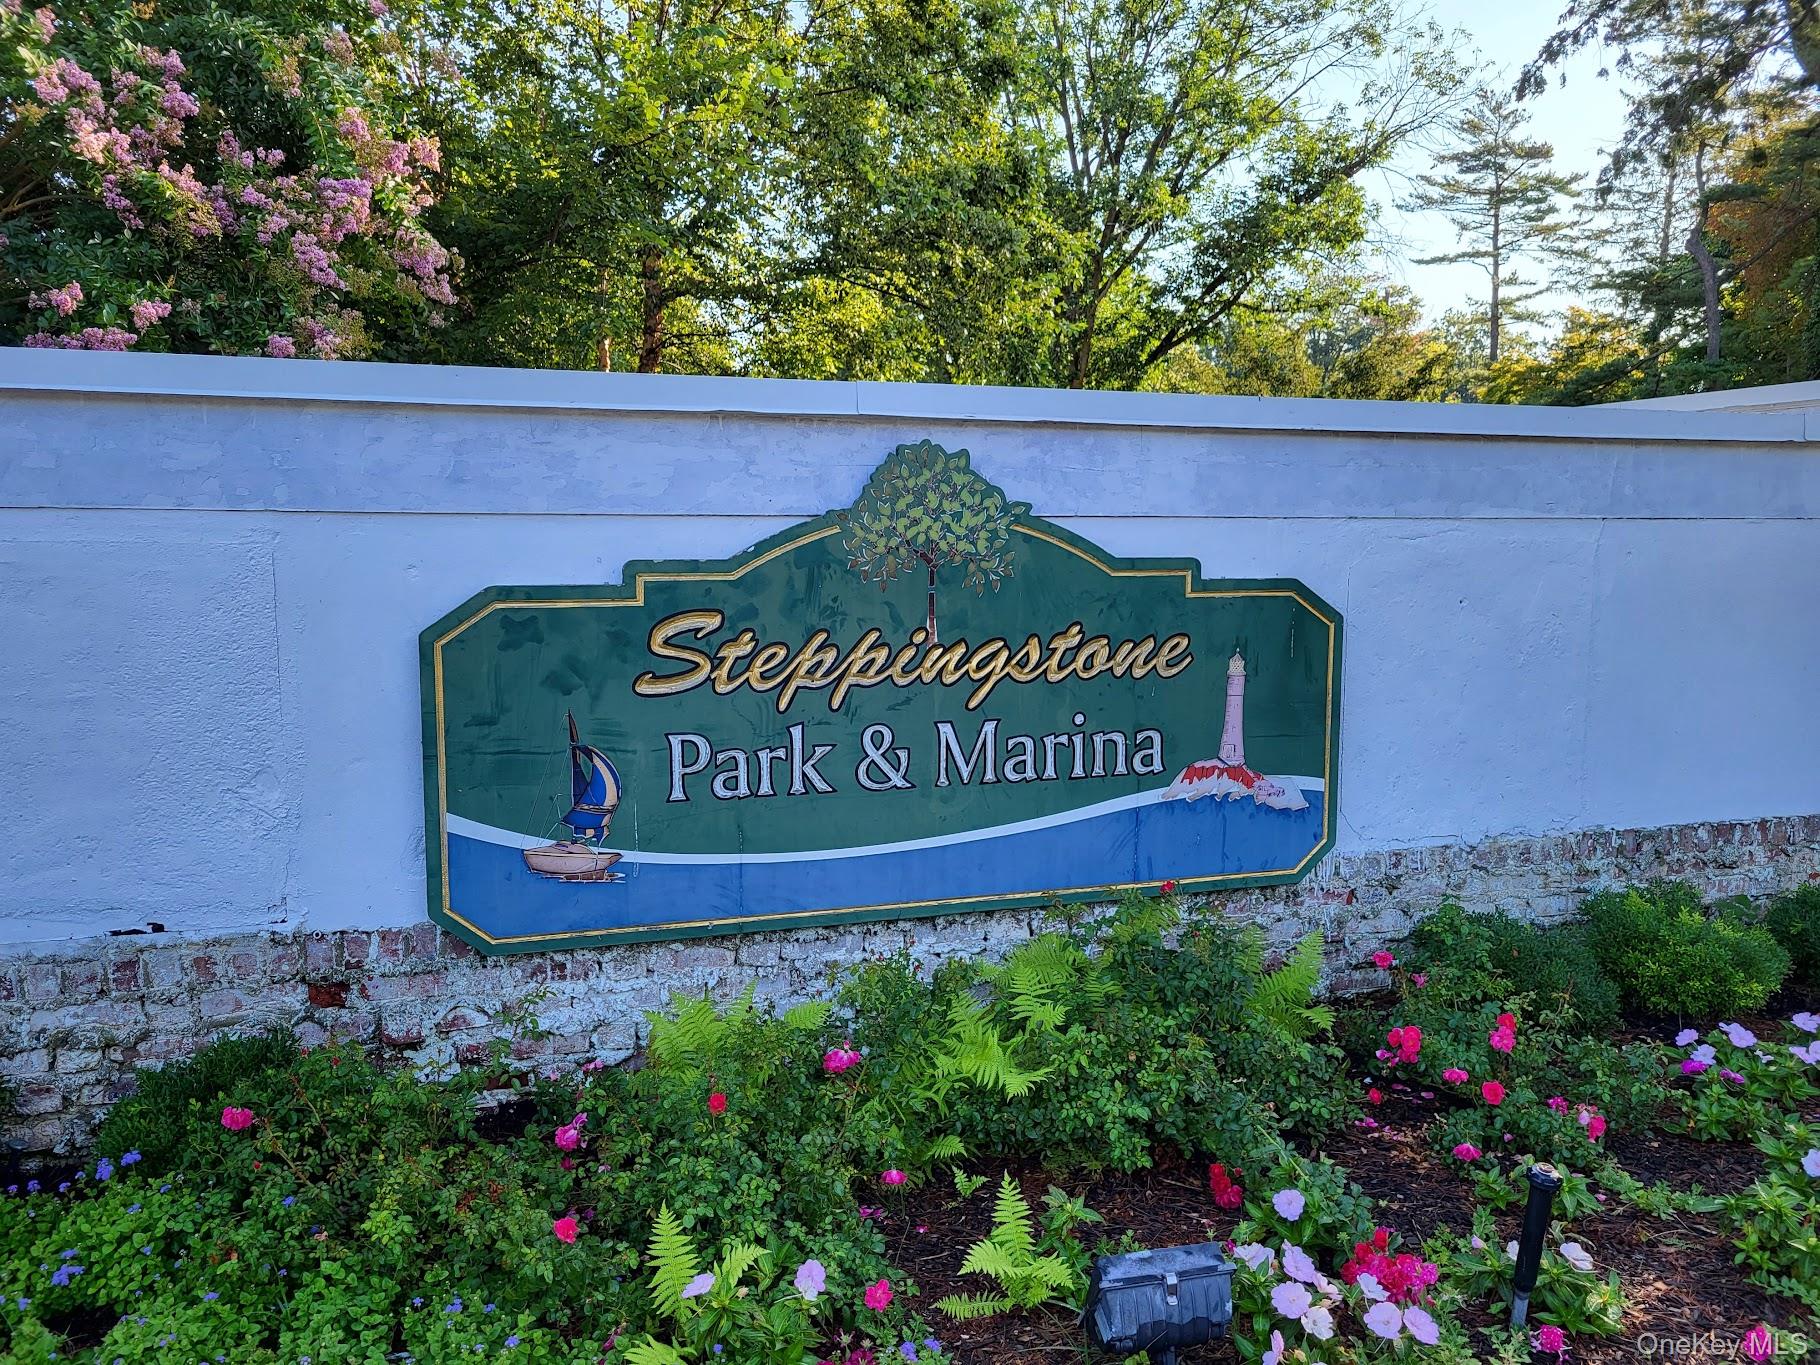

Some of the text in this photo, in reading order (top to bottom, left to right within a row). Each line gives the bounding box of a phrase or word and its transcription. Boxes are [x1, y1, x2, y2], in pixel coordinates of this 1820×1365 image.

[633, 609, 1193, 713] Steppingstone
[666, 711, 1165, 804] Park & Marina
